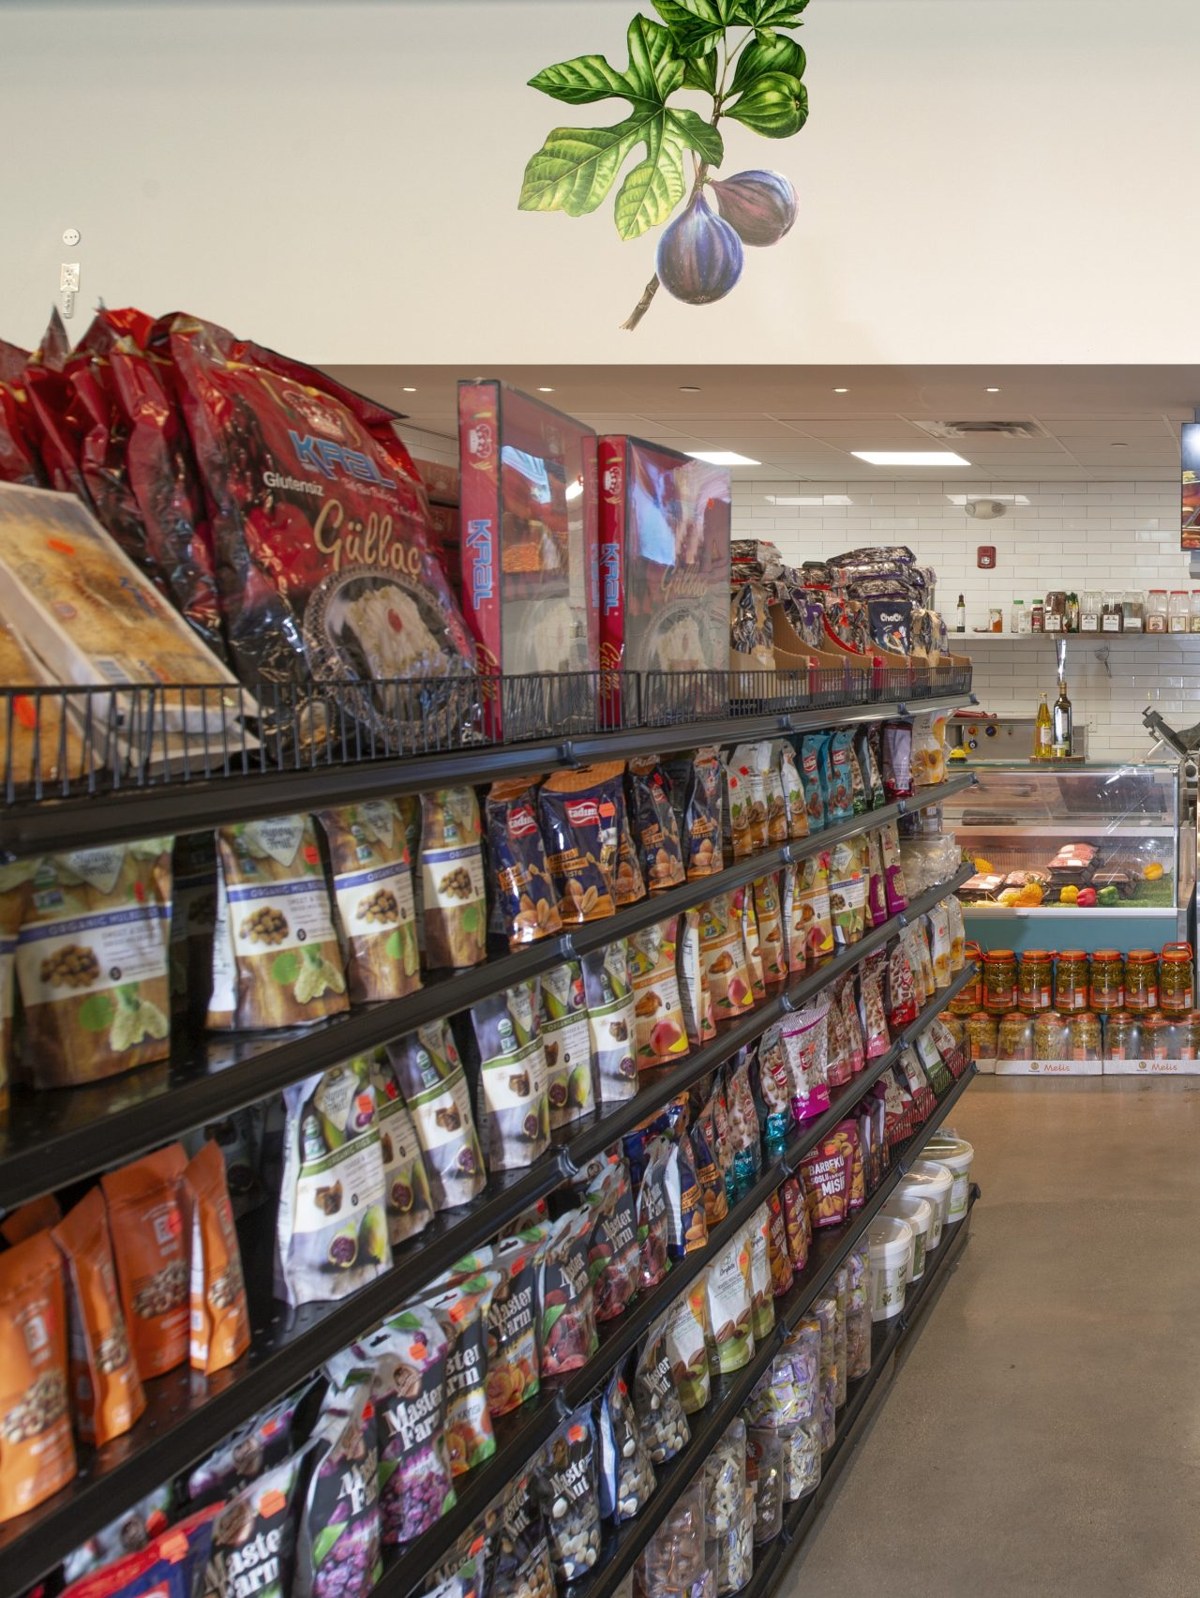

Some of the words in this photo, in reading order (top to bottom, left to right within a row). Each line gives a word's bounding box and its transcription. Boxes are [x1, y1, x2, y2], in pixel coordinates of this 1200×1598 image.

[262, 471, 324, 496] Glutensiz
[313, 499, 423, 586] Güllaç
[601, 1208, 632, 1242] Master
[486, 1287, 532, 1330] Master
[497, 1308, 531, 1338] Farm
[446, 1343, 480, 1376] ster
[641, 1356, 671, 1391] Master
[653, 1377, 672, 1396] Nut
[564, 1475, 590, 1501] Nut
